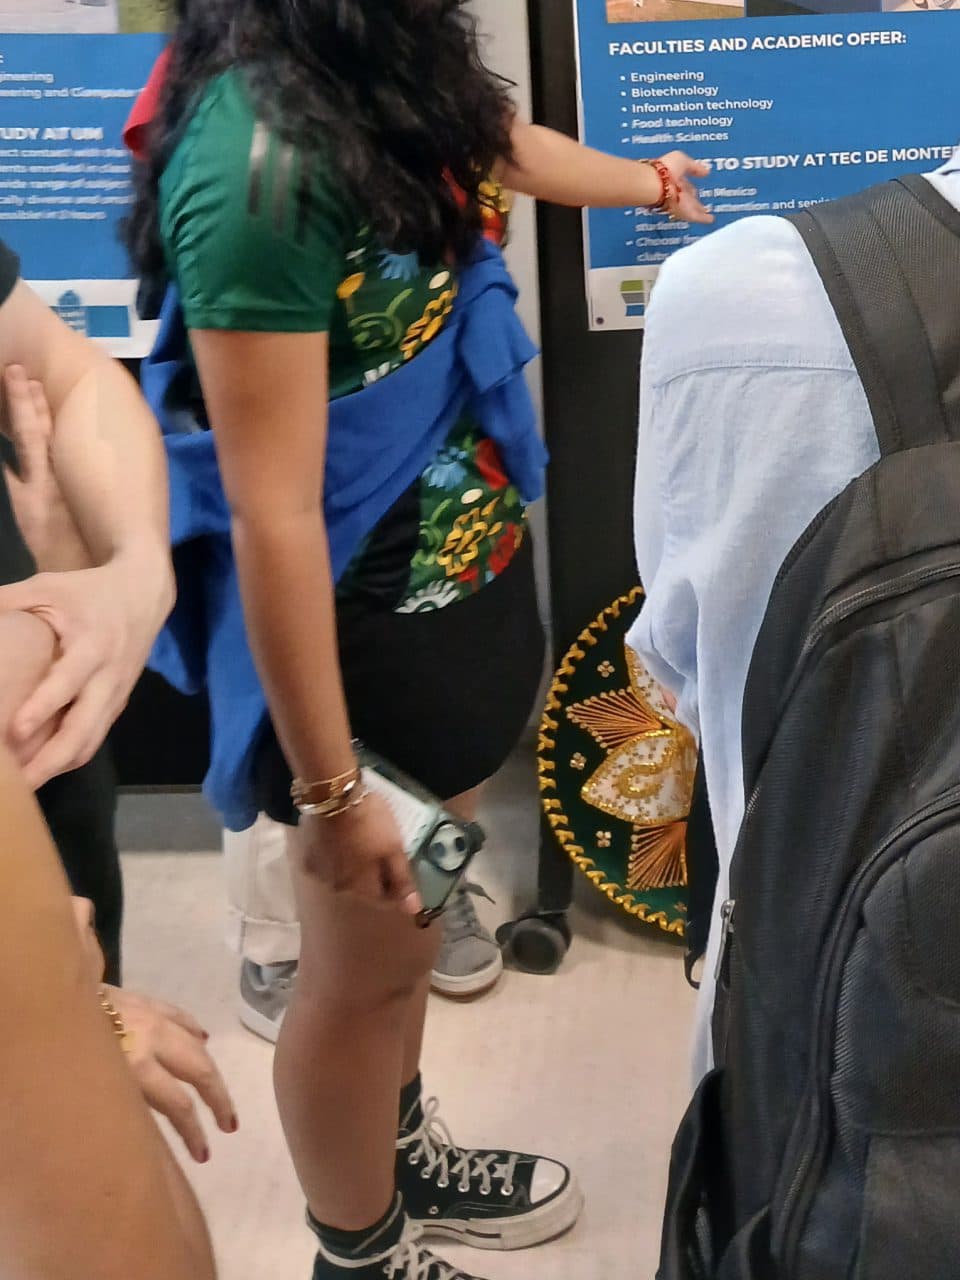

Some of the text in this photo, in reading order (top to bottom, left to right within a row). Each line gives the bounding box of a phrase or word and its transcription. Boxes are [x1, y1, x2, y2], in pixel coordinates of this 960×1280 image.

[608, 31, 907, 56] FACULTIES AND ACADEMIC OFFER:
[630, 71, 705, 84] Engineering
[631, 86, 719, 98] Biotechnology
[631, 99, 774, 114] Information technology
[631, 116, 734, 129] Food technology
[676, 131, 729, 143] Sciences
[713, 158, 740, 171] TO
[743, 155, 799, 170] STUDY
[803, 153, 827, 167] AT
[829, 151, 861, 166] TEC
[865, 149, 888, 163] DE
[772, 198, 796, 210] and
